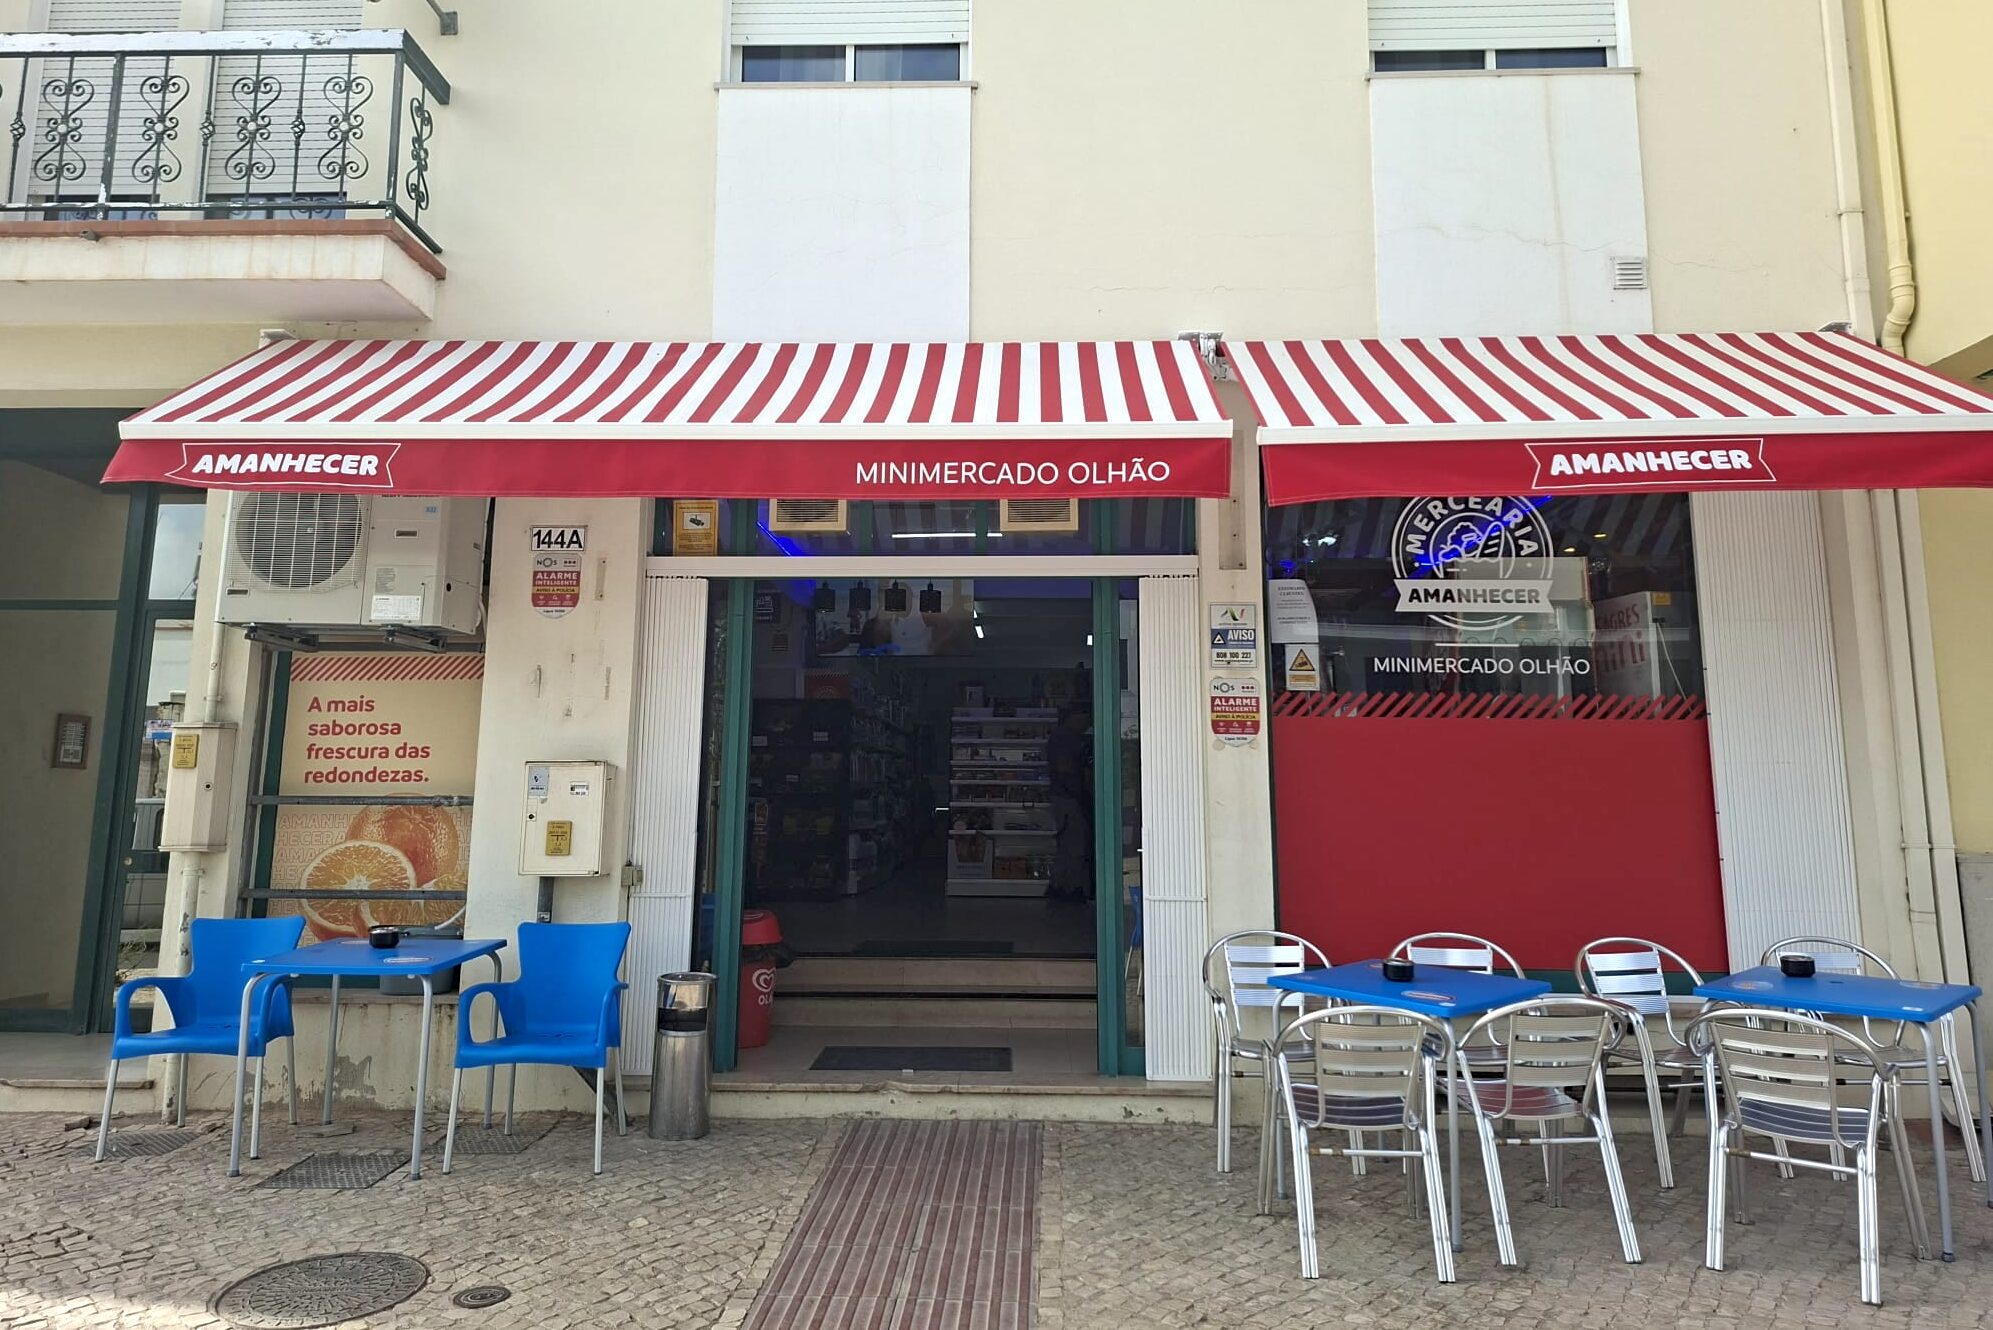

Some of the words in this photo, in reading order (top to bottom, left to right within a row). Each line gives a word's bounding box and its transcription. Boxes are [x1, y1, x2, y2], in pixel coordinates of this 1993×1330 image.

[192, 453, 379, 476] AMANHECER
[856, 461, 1059, 484] MINIMERCADO
[1068, 457, 1170, 484] OLHÃO
[1551, 449, 1752, 476] AMANHECER
[1405, 497, 1539, 556] MERCEARIA
[533, 529, 583, 549] 144A
[536, 557, 558, 568] NOS
[536, 572, 578, 580] ALARME
[1408, 588, 1540, 604] AMANHECER
[1228, 630, 1255, 641] AVISO
[1374, 656, 1514, 674] MINIMERCADO
[1519, 655, 1591, 675] OLHÃO
[1213, 682, 1235, 693] NOS
[307, 696, 322, 712] A
[326, 694, 375, 712] mais
[308, 719, 402, 736] saborosa
[306, 743, 390, 760] frescura
[394, 742, 431, 759] das
[304, 766, 429, 784] redondezas.
